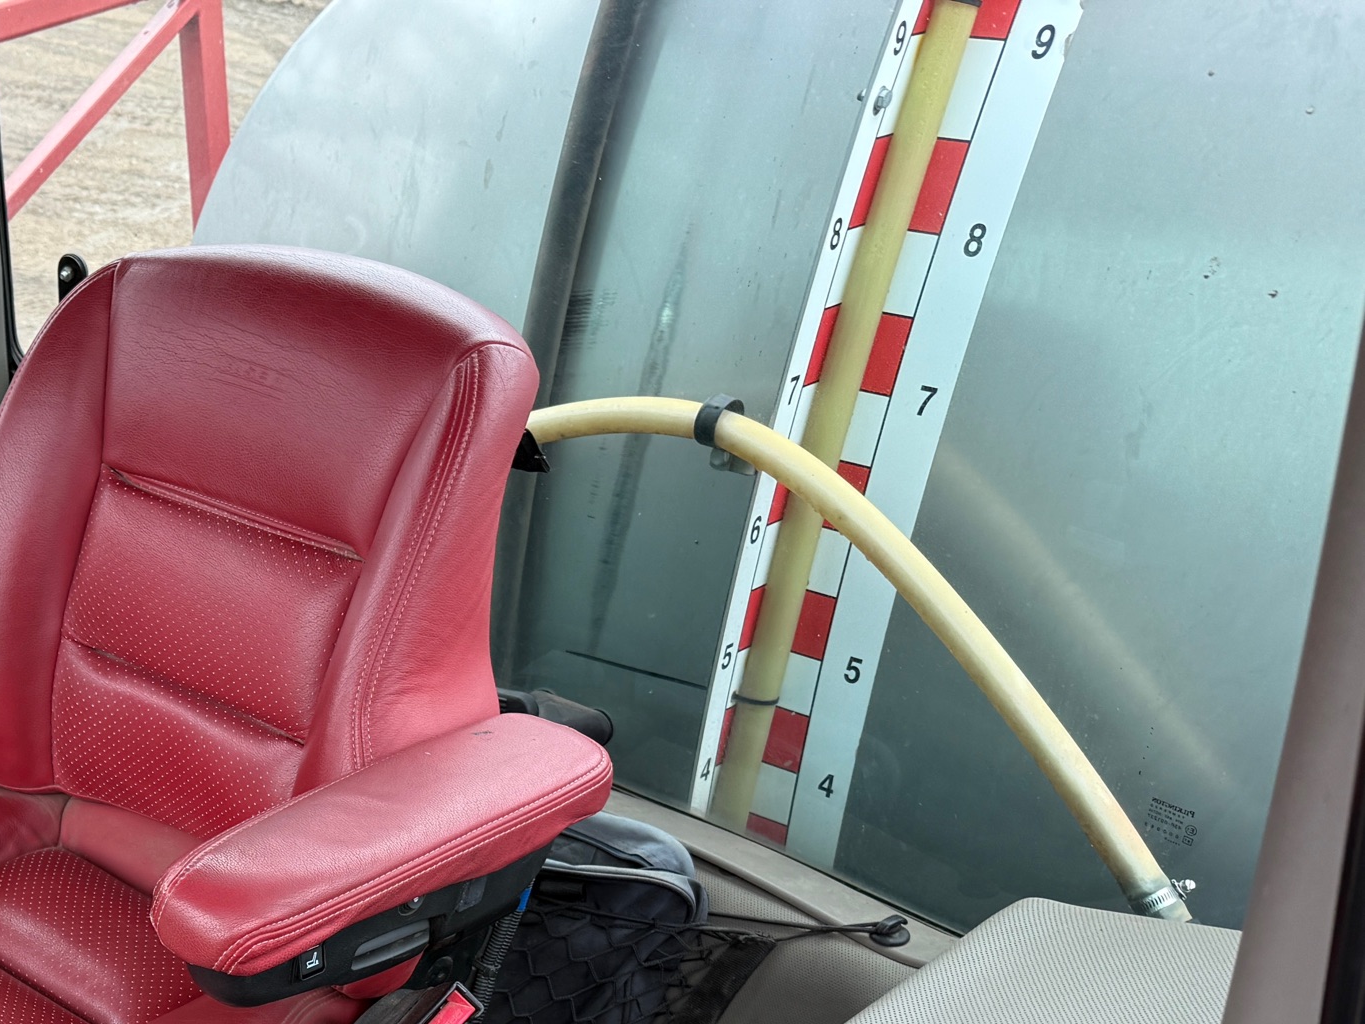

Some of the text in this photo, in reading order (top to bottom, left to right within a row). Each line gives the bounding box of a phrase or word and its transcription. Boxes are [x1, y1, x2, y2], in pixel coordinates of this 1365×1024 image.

[893, 20, 907, 56] 9
[1031, 24, 1056, 60] 9
[829, 217, 843, 251] 8
[963, 222, 987, 258] 8
[787, 374, 801, 406] 7
[916, 384, 939, 417] 7
[749, 515, 762, 545] 6
[721, 642, 734, 670] 5
[843, 655, 864, 684] 5
[700, 757, 712, 782] 4
[817, 773, 835, 799] 4
